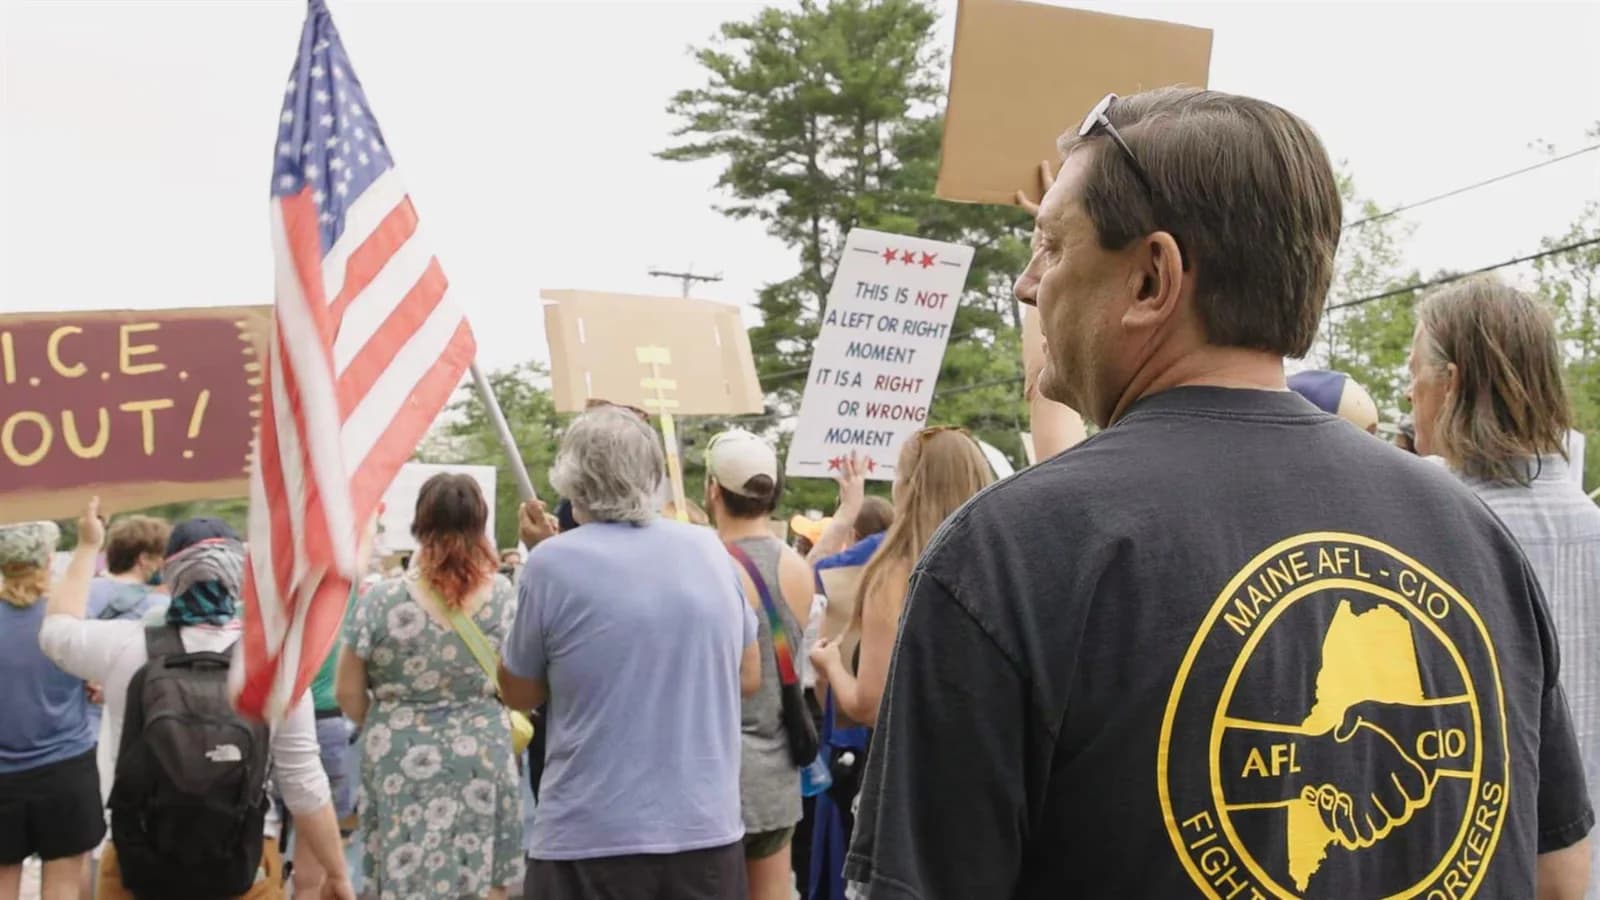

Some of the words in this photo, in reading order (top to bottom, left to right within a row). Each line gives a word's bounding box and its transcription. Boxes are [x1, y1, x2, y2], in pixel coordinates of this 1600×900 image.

[855, 281, 889, 301] THIS
[894, 287, 909, 304] IS
[914, 290, 948, 310] NOT
[825, 309, 838, 326] A
[840, 311, 874, 330] LEFT
[877, 315, 899, 333] OR
[902, 319, 949, 339] RIGHT
[1, 322, 189, 386] I.C.E.
[845, 341, 916, 364] MOMENT
[816, 368, 832, 385] IT
[834, 370, 850, 386] IS
[851, 372, 862, 388] A
[873, 373, 924, 394] RIGHT
[837, 400, 860, 417] OR
[866, 402, 926, 422] WRONG
[1, 389, 210, 466] OUT!
[824, 428, 894, 447] MOMENT
[1223, 551, 1314, 636] MAINE
[1398, 569, 1450, 620] CIO
[1416, 728, 1466, 761] CIO
[1241, 743, 1301, 778] AFL
